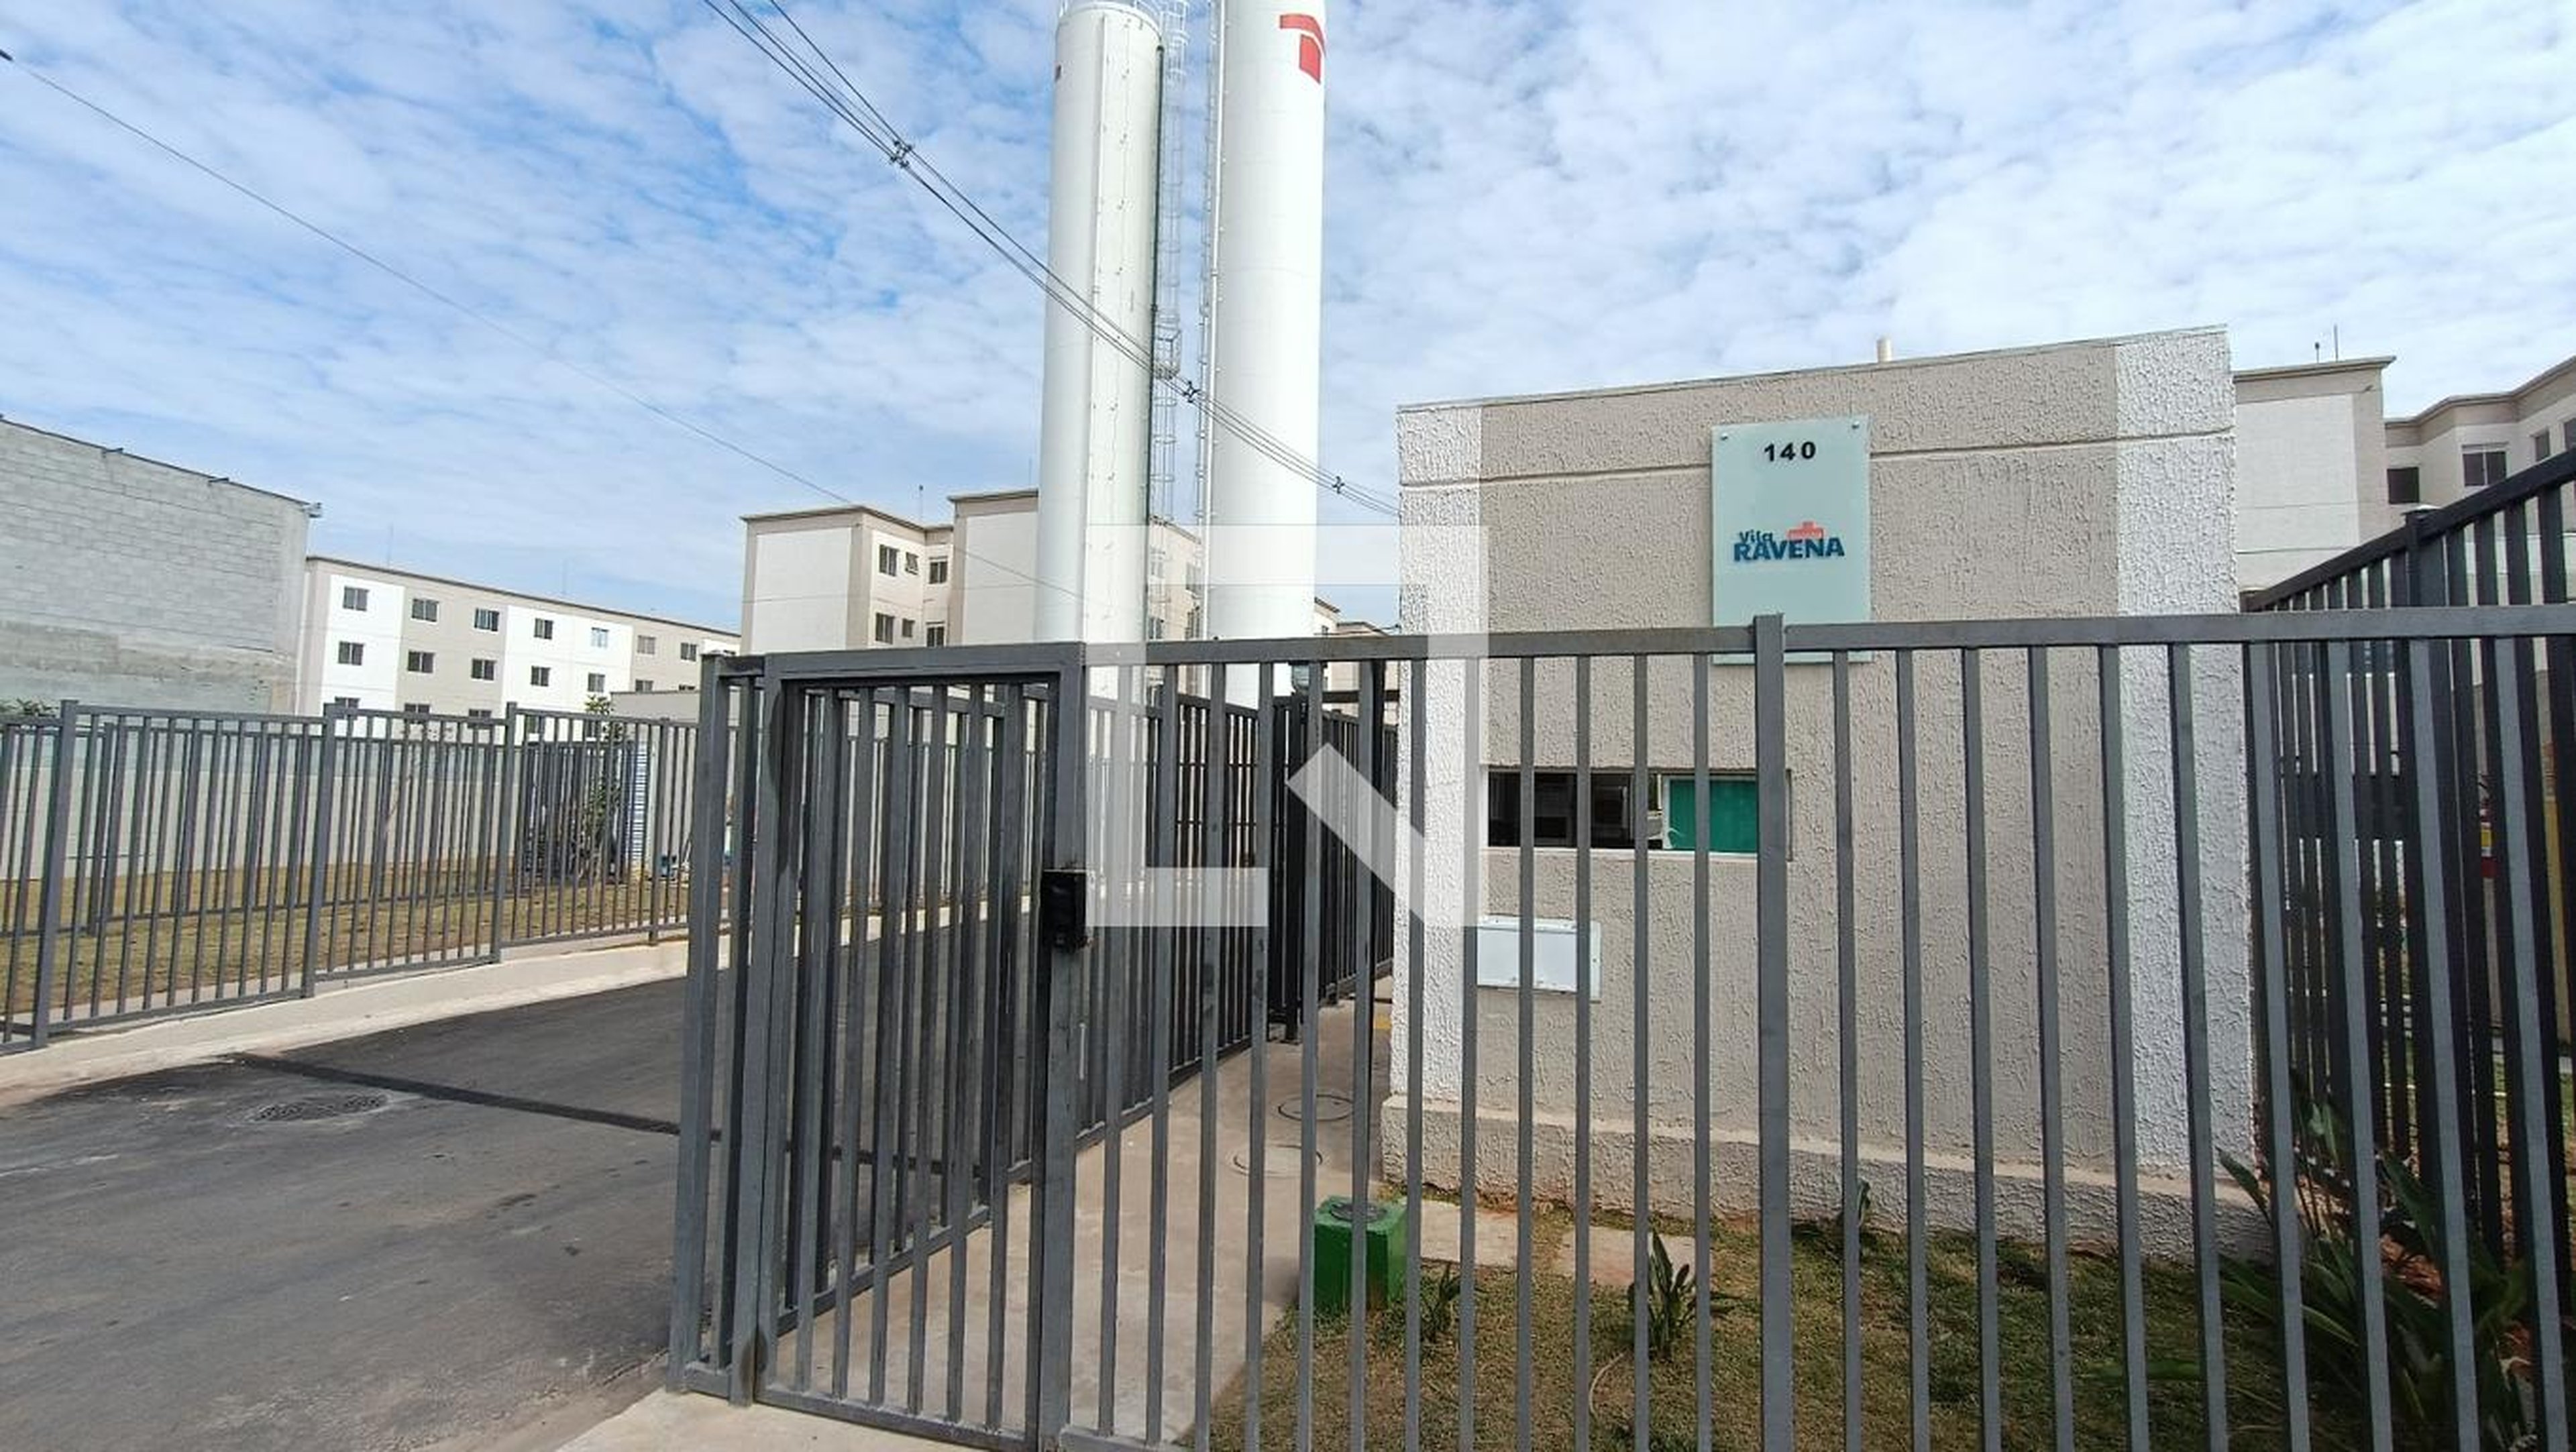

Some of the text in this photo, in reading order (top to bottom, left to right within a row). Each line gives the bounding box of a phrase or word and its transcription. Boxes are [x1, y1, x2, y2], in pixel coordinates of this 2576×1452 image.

[1764, 441, 1816, 462] 140
[1739, 529, 1773, 543] Vila
[1733, 537, 1845, 561] RAVENA
